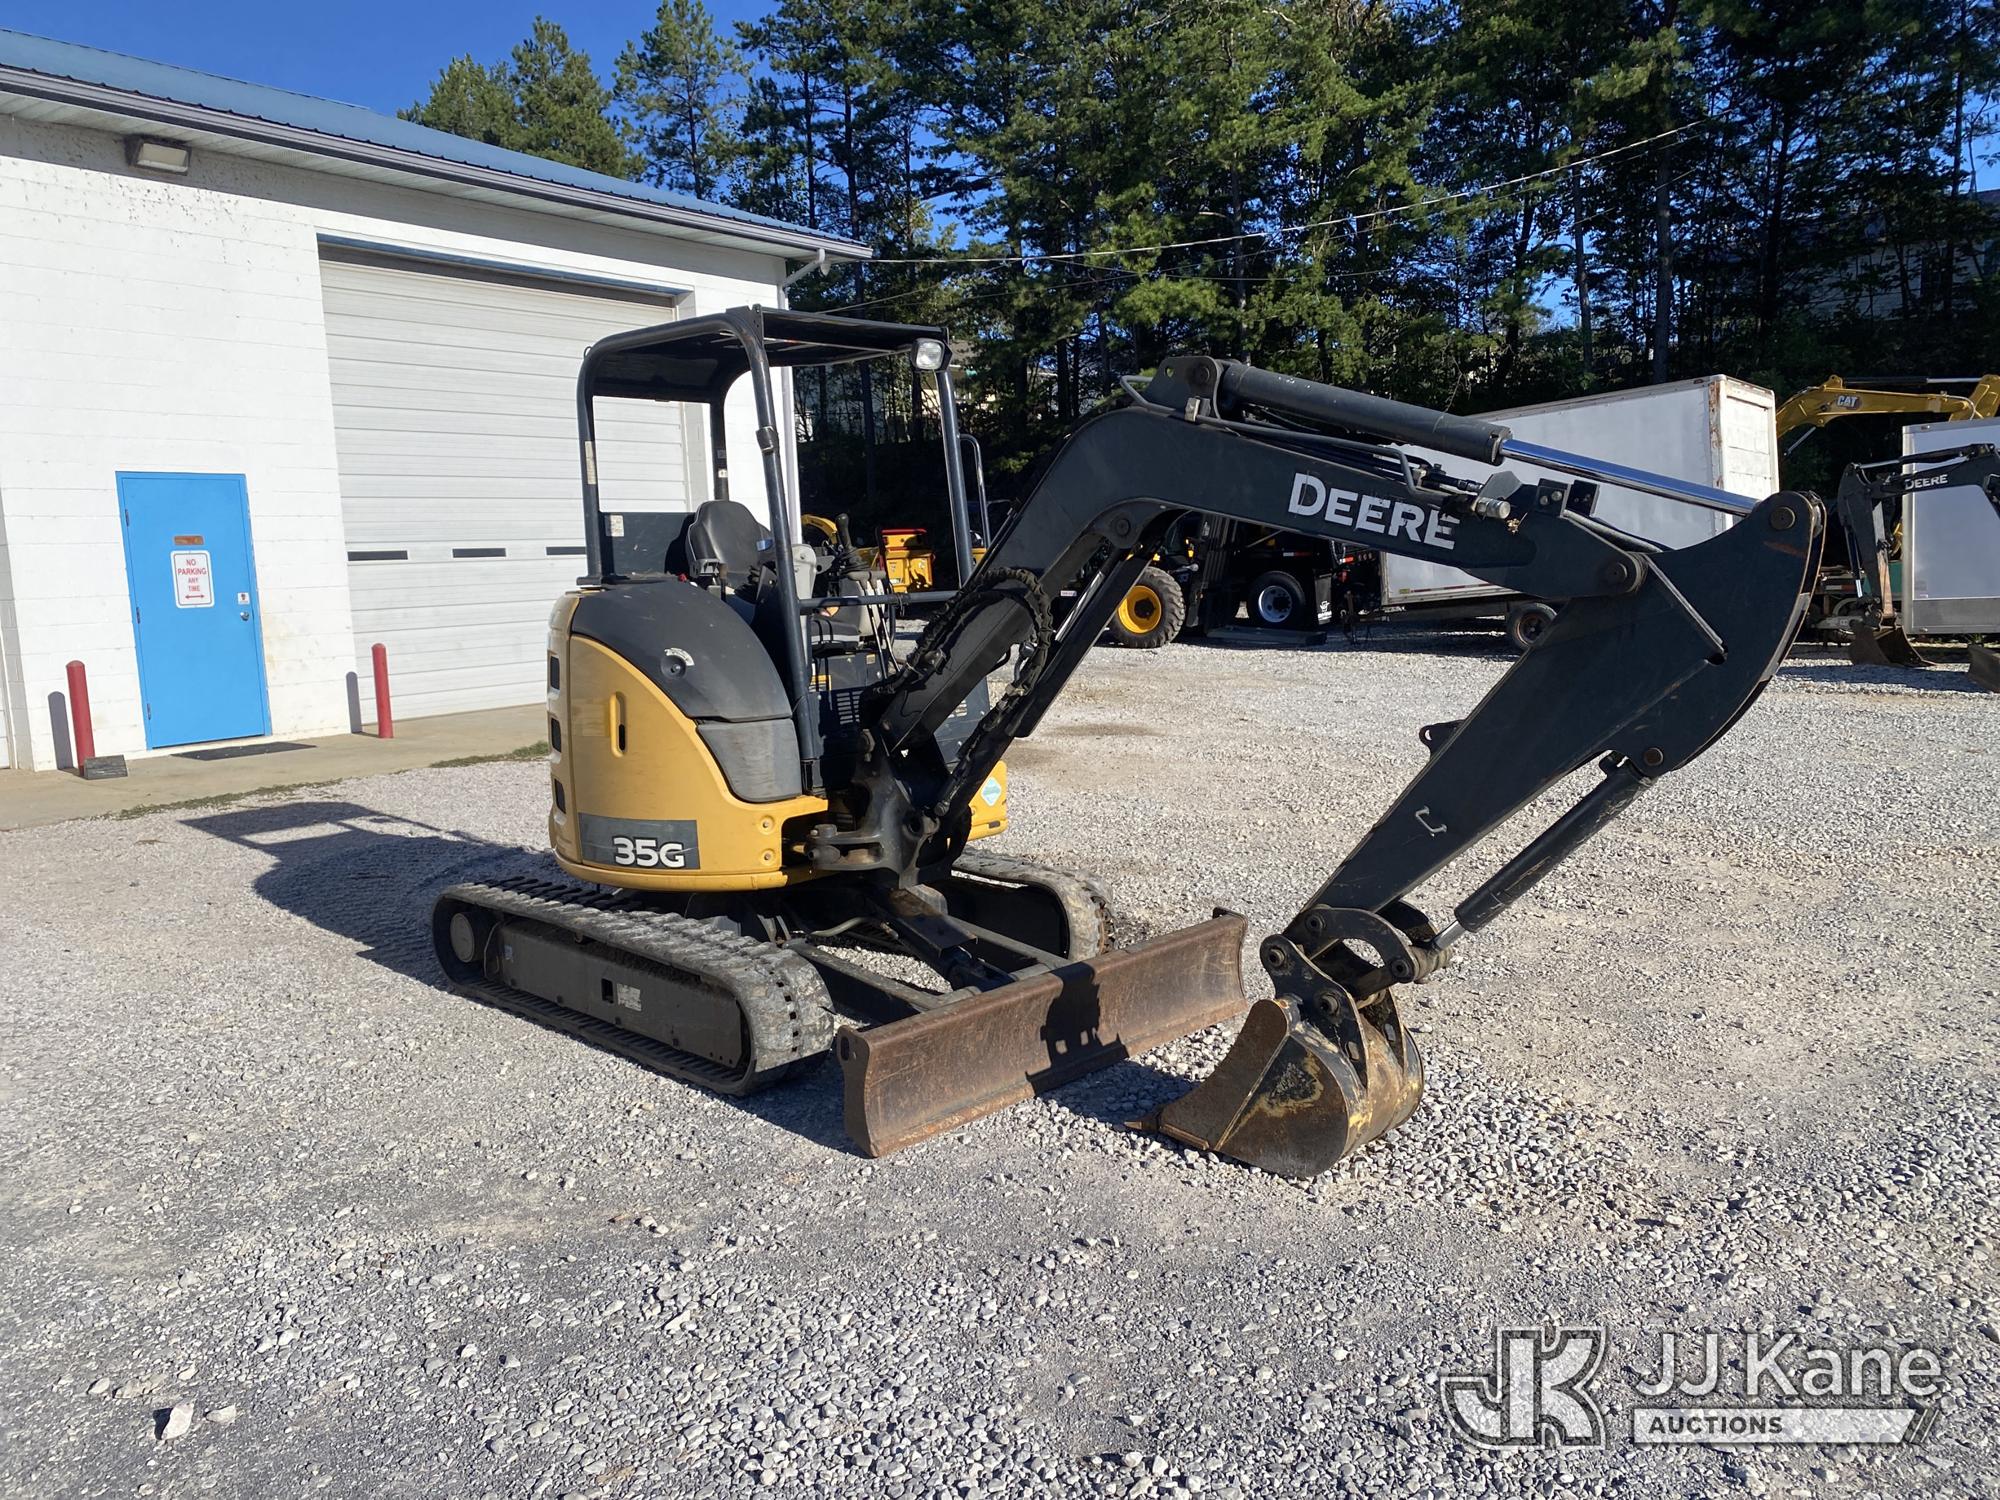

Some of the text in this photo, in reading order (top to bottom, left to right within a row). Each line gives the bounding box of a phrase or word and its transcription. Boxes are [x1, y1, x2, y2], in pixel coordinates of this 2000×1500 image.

[1837, 395, 1858, 408] CAT
[1904, 474, 1949, 490] DEERE
[1287, 472, 1461, 550] DEERE
[612, 836, 686, 869] 35G
